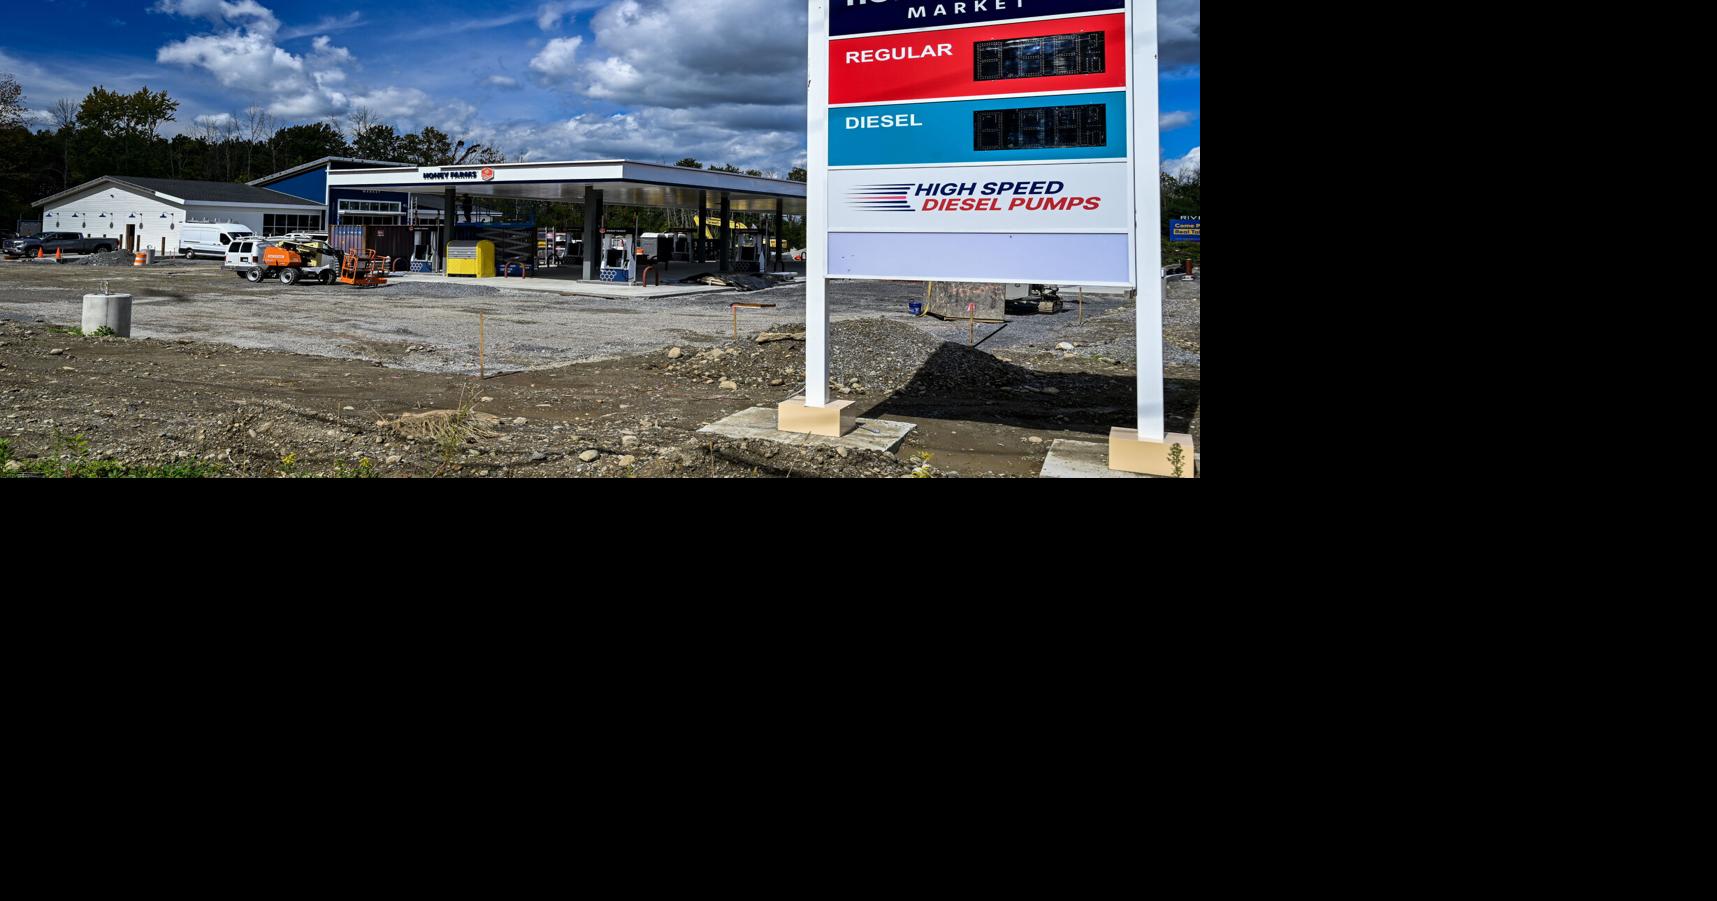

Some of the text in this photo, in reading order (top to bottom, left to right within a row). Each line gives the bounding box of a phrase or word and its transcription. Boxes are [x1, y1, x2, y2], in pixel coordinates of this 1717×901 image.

[845, 43, 953, 64] REGULAR
[845, 114, 923, 130] DIESEL
[423, 172, 449, 180] HONEY
[915, 181, 1064, 197] HIGH SPEED
[921, 196, 1102, 212] DIESEL PUMPS
